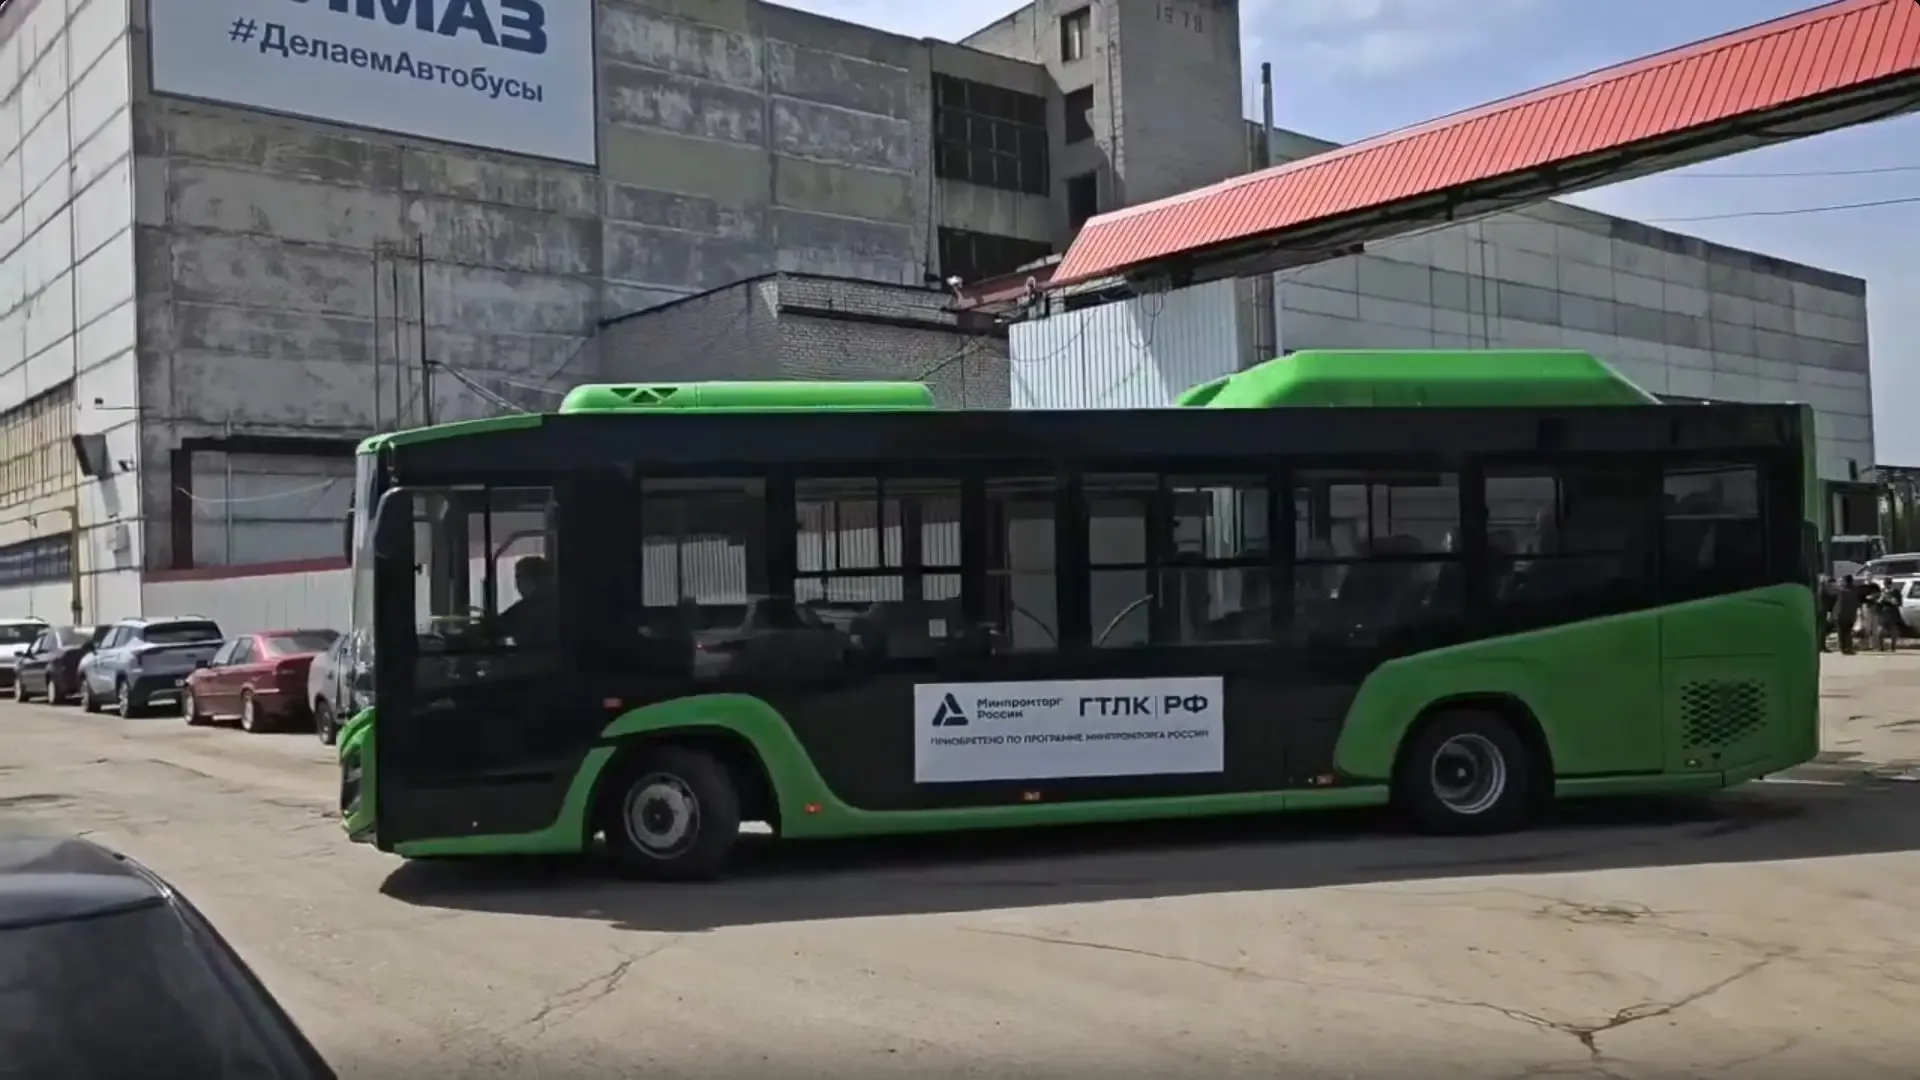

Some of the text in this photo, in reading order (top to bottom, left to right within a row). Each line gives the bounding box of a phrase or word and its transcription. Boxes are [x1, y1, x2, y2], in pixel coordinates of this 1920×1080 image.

[290, 0, 547, 54] МАЗ
[1155, 3, 1203, 33] 1978
[228, 17, 544, 102] #ДелаемАвтобусы
[976, 697, 1063, 709] Минпромторг
[1079, 694, 1208, 716] ГТЛК РФ
[976, 710, 1024, 720] России
[930, 735, 1004, 746] ПРИОБРЕТЕНО
[1006, 735, 1022, 745] ПО
[1023, 733, 1083, 744] ПРОГРАММЕ
[1166, 729, 1209, 740] РОССИИ
